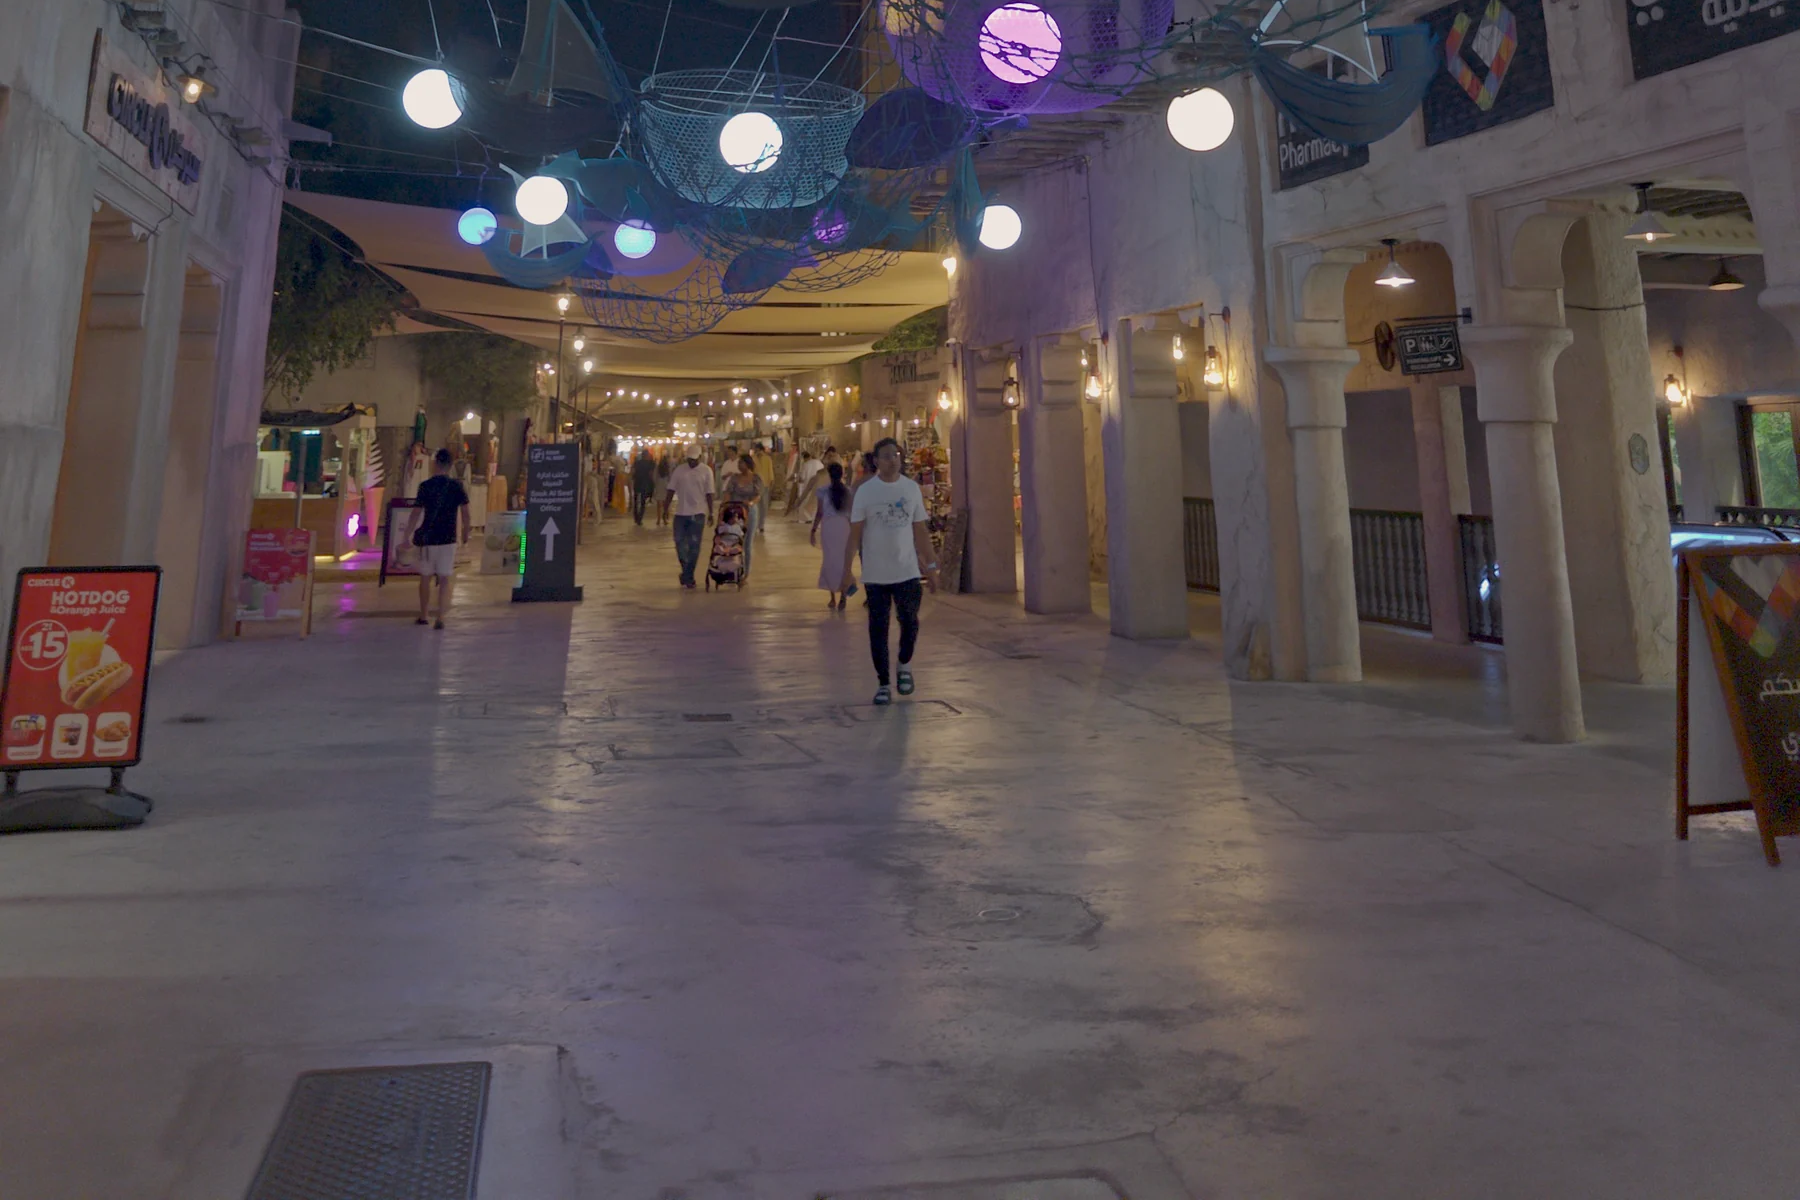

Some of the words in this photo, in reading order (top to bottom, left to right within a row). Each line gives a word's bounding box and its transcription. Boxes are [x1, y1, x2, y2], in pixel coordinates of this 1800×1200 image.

[27, 578, 60, 587] CIRCLE
[51, 590, 130, 605] HOTDOG
[99, 604, 126, 615] Juice
[29, 630, 66, 659] 15
